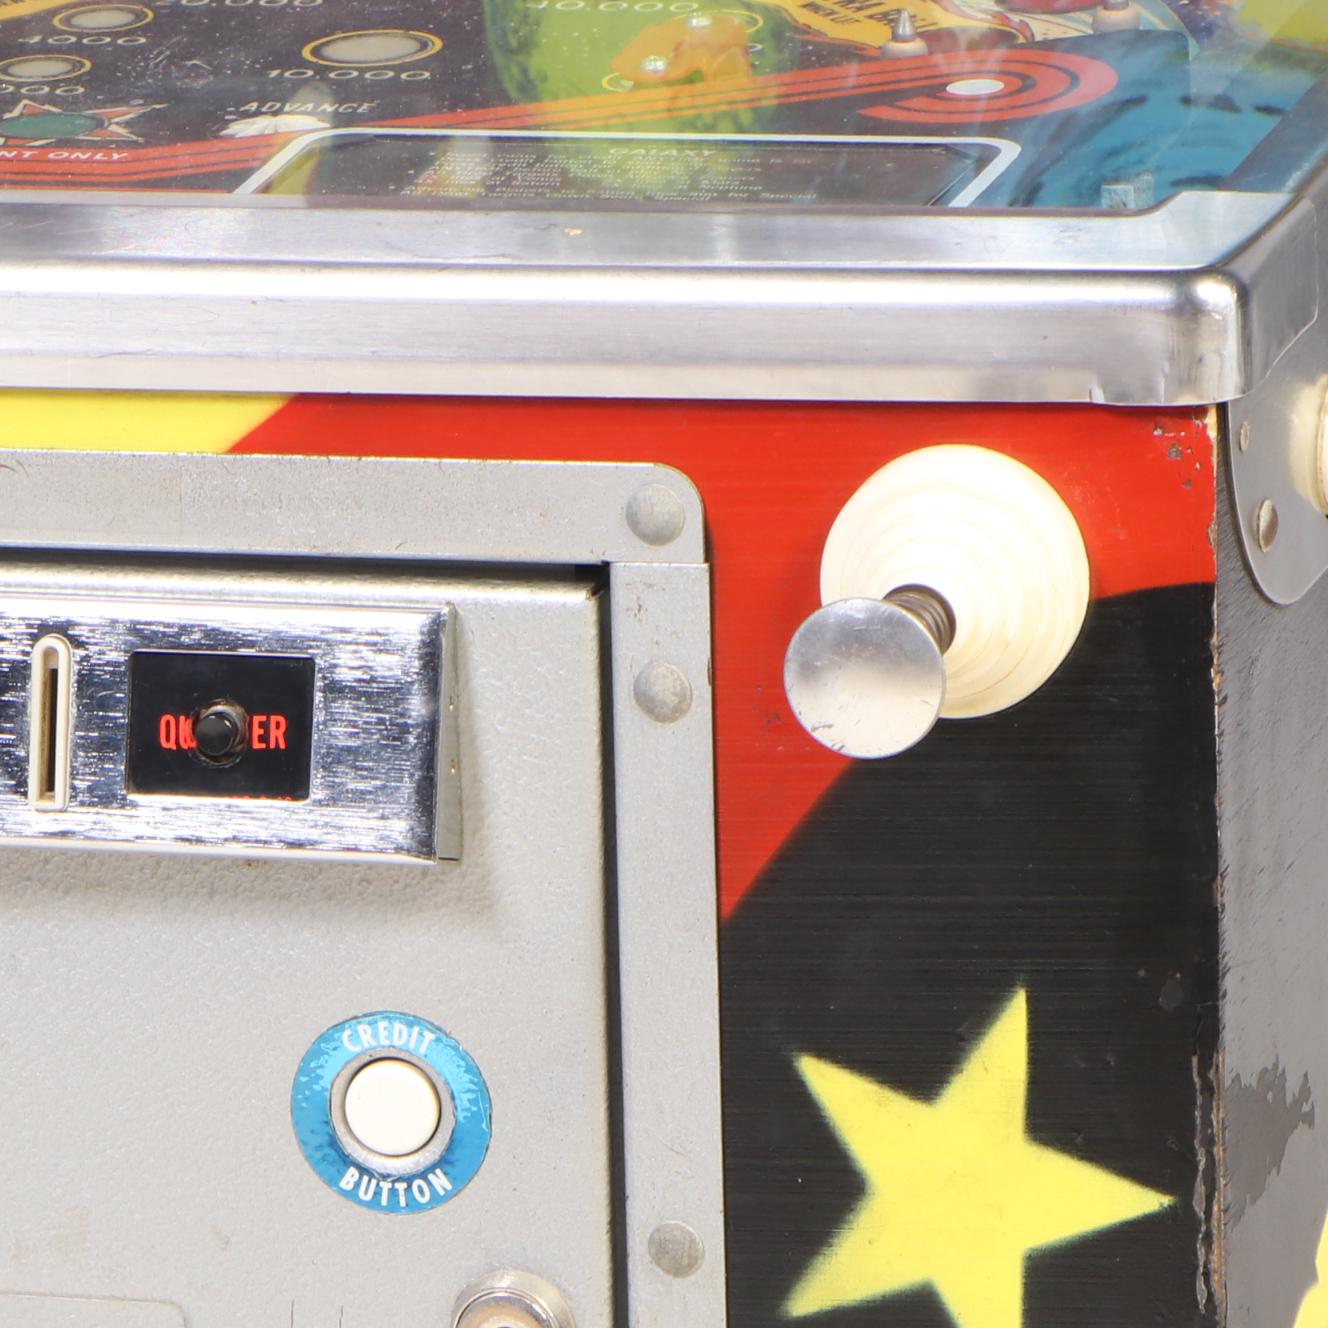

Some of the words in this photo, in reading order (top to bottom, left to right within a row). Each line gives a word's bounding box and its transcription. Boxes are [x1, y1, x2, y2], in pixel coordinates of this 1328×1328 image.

[16, 35, 147, 46] 4000
[239, 101, 377, 113] ADVANCE
[47, 151, 129, 160] ONLY
[159, 713, 289, 750] QUER
[341, 1020, 438, 1054] CREDIT
[339, 1166, 454, 1208] BUTTON
